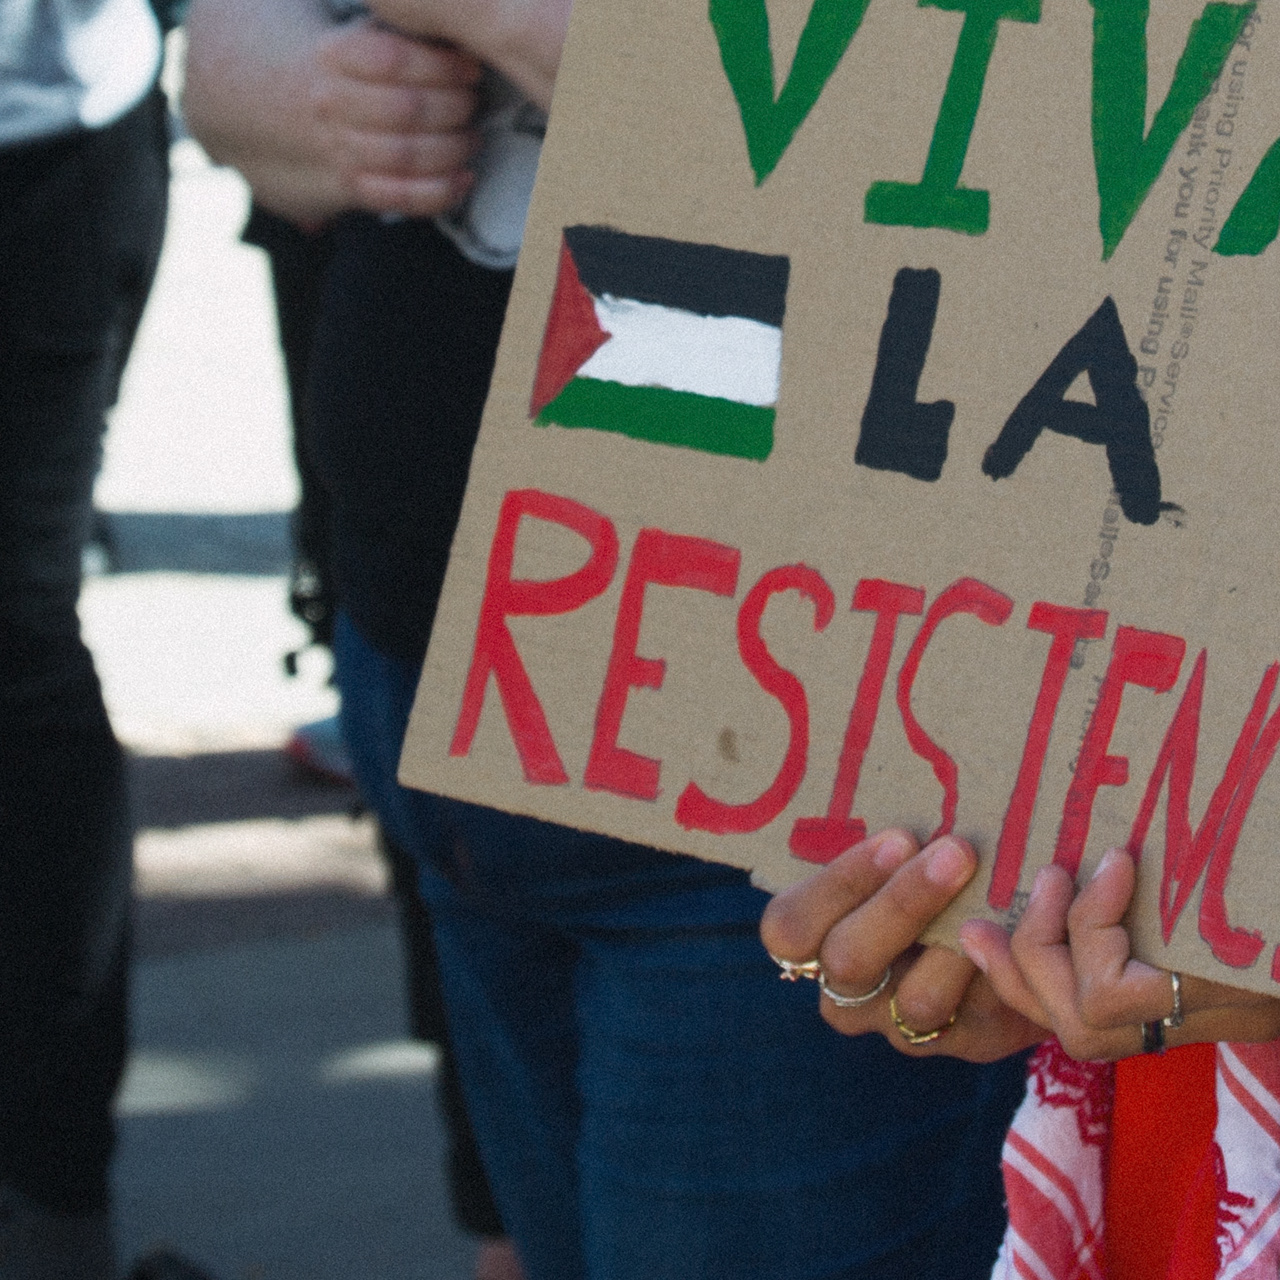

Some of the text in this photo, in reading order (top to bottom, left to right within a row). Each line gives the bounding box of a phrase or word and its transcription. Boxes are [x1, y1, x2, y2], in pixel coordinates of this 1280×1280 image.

[1215, 58, 1248, 138] using
[1174, 166, 1197, 219] you
[1192, 147, 1232, 250] Priority
[1163, 227, 1188, 269] for
[1139, 276, 1173, 356] using
[854, 266, 1164, 525] LA
